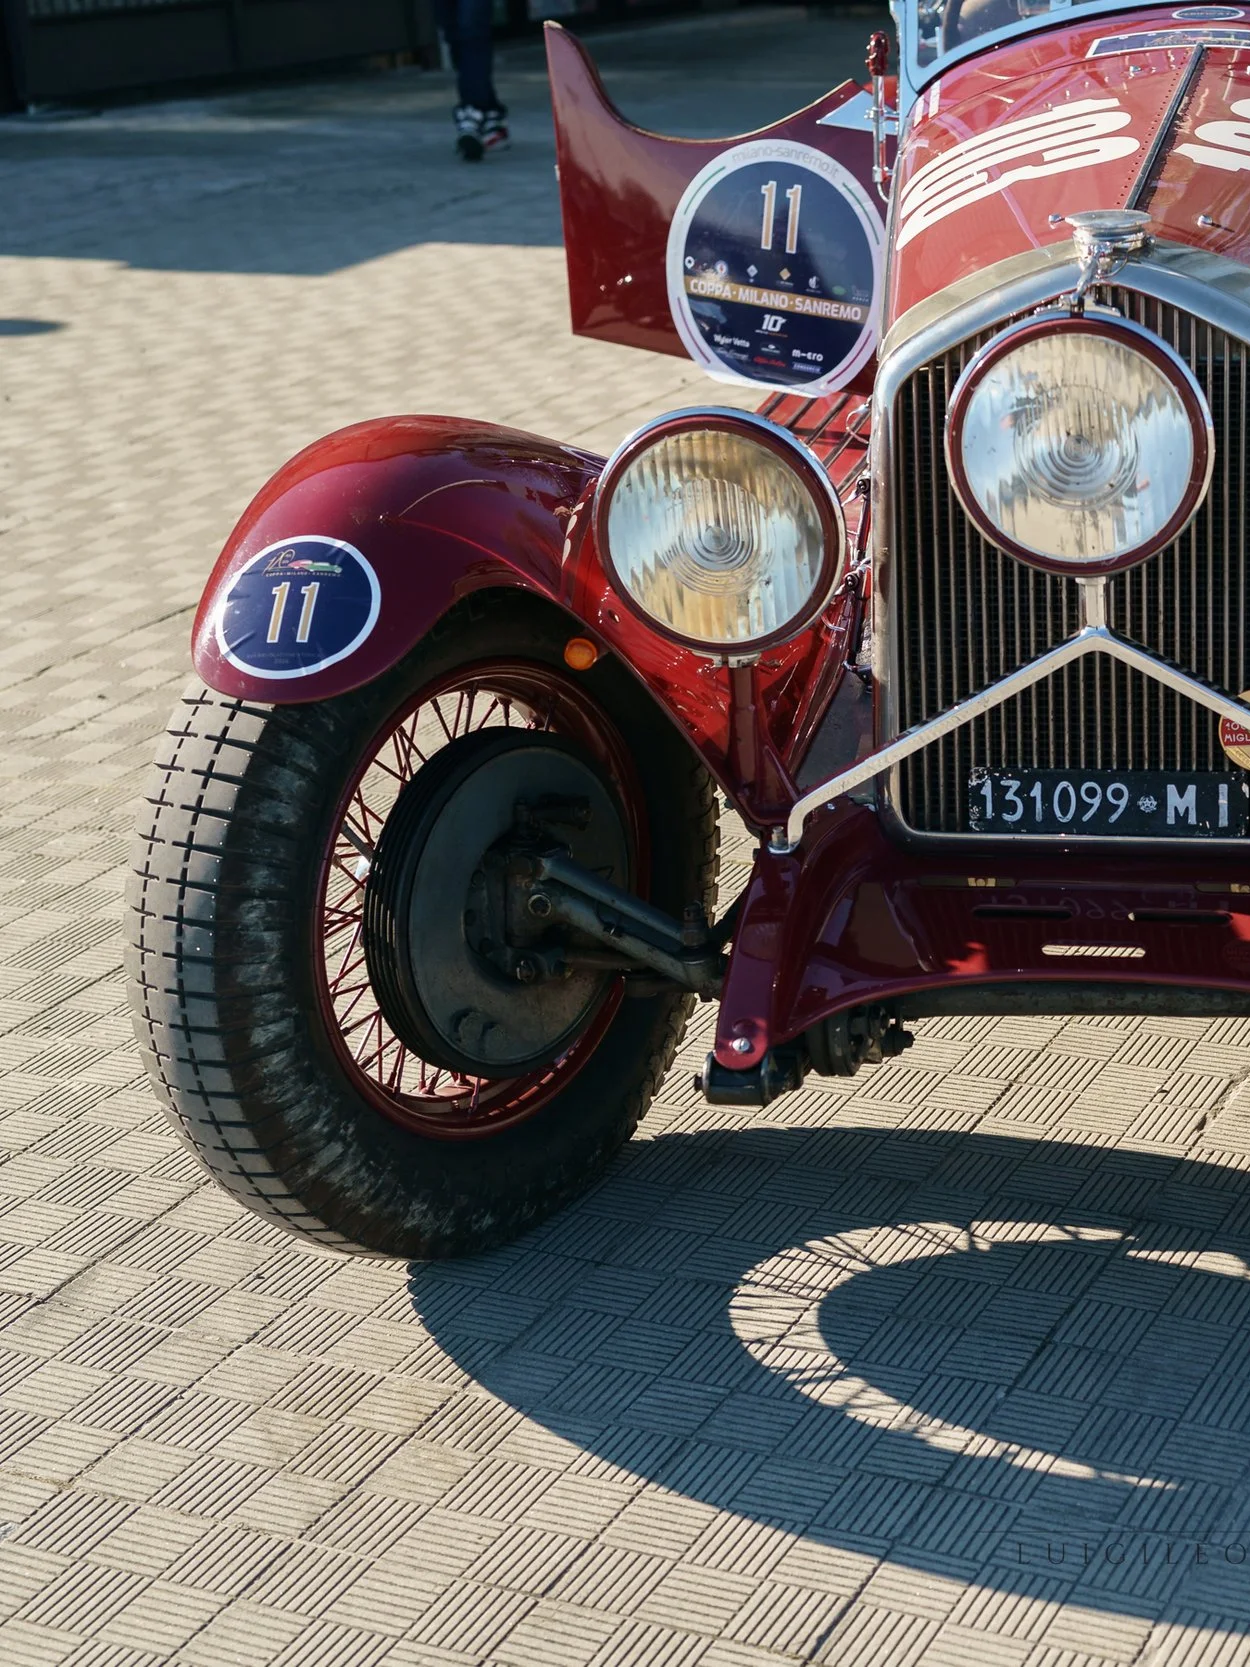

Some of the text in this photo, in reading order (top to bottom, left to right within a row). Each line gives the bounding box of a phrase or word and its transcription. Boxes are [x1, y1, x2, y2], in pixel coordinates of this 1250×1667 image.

[732, 145, 840, 178] milano-sanremo.it
[761, 180, 802, 254] 11
[689, 278, 861, 321] COPPA MILANO SANREMO
[266, 581, 320, 643] 11
[979, 778, 1130, 824] 131099
